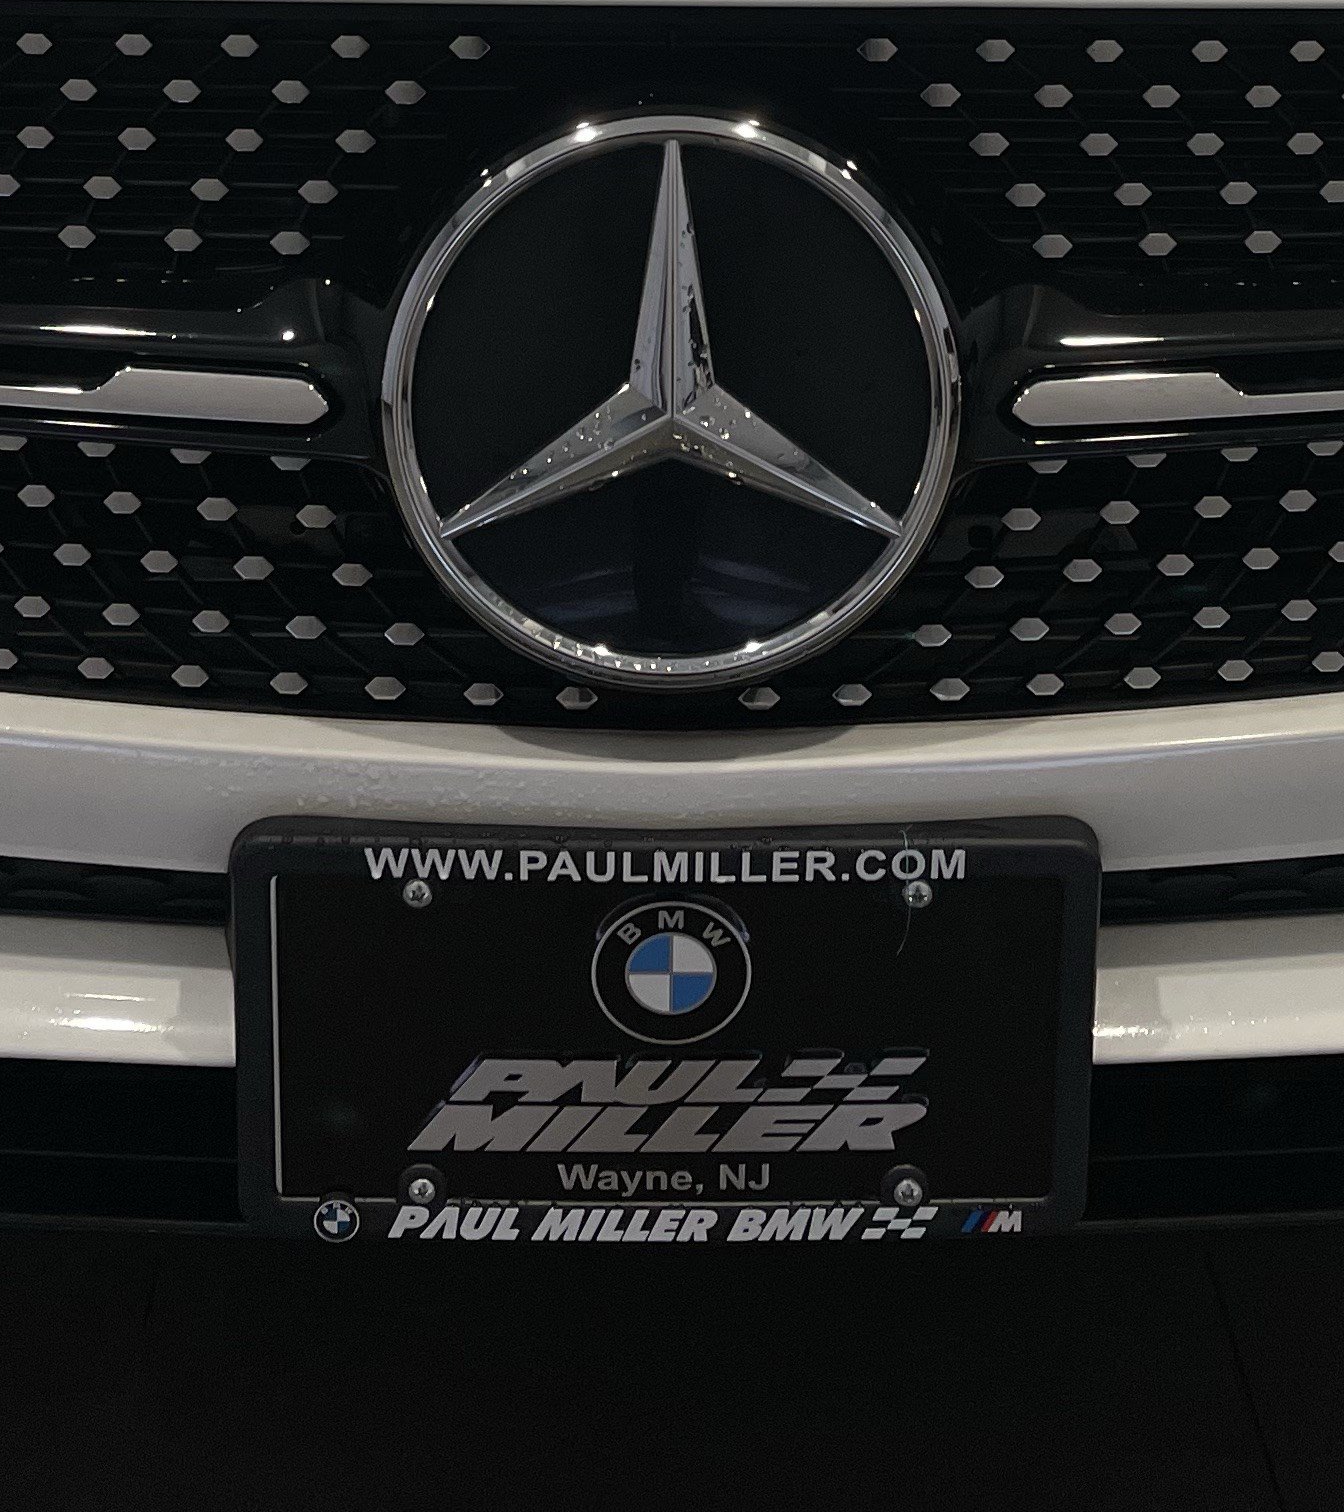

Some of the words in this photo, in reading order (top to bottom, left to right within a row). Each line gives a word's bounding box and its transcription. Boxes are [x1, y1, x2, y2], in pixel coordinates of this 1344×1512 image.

[364, 846, 967, 884] WWW.PAULMILLER.COM
[616, 909, 732, 948] BMW
[448, 1058, 764, 1105] PAUL
[406, 1102, 929, 1153] MILLER
[557, 1163, 704, 1197] Wayne,
[720, 1163, 771, 1191] NJ
[387, 1206, 524, 1241] PAUL
[531, 1206, 723, 1242] MILLER
[727, 1207, 863, 1242] BMW
